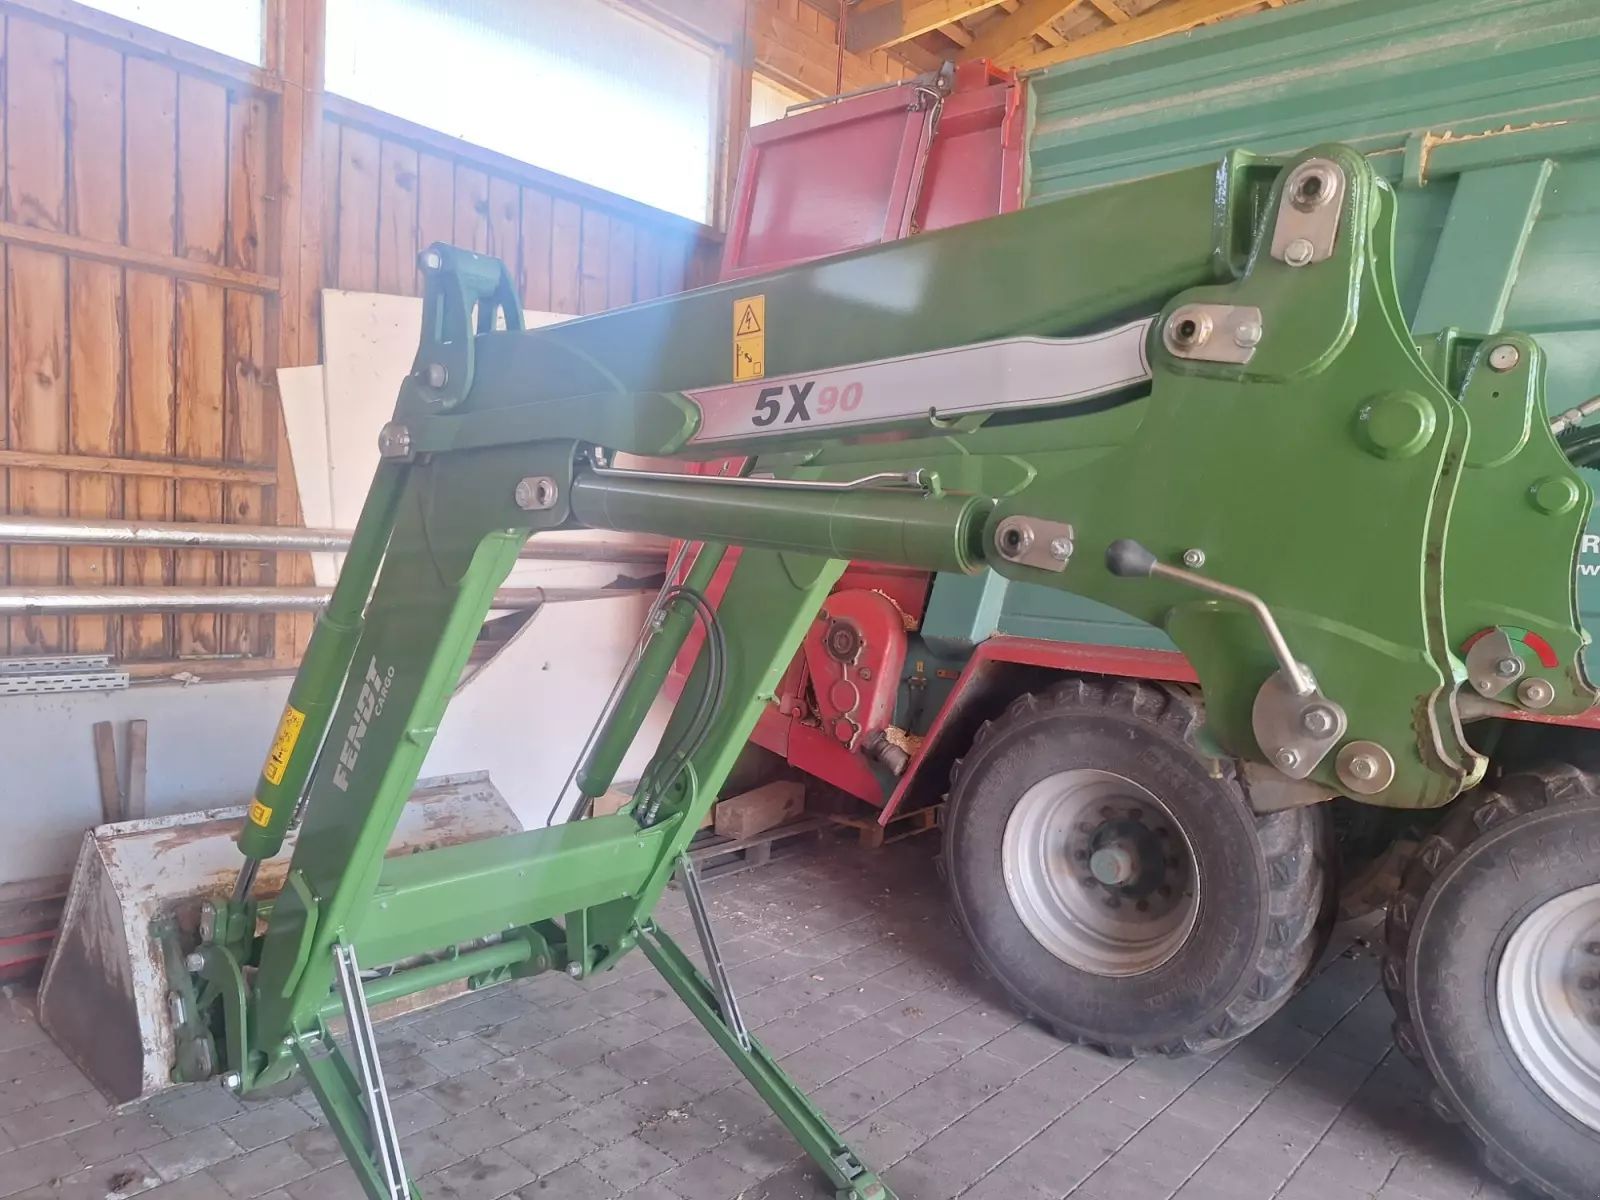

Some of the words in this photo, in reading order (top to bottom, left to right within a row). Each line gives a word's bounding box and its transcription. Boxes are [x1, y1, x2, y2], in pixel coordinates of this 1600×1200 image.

[752, 381, 864, 427] 5X90
[375, 665, 395, 716] CARGO
[332, 654, 382, 792] FENDT
